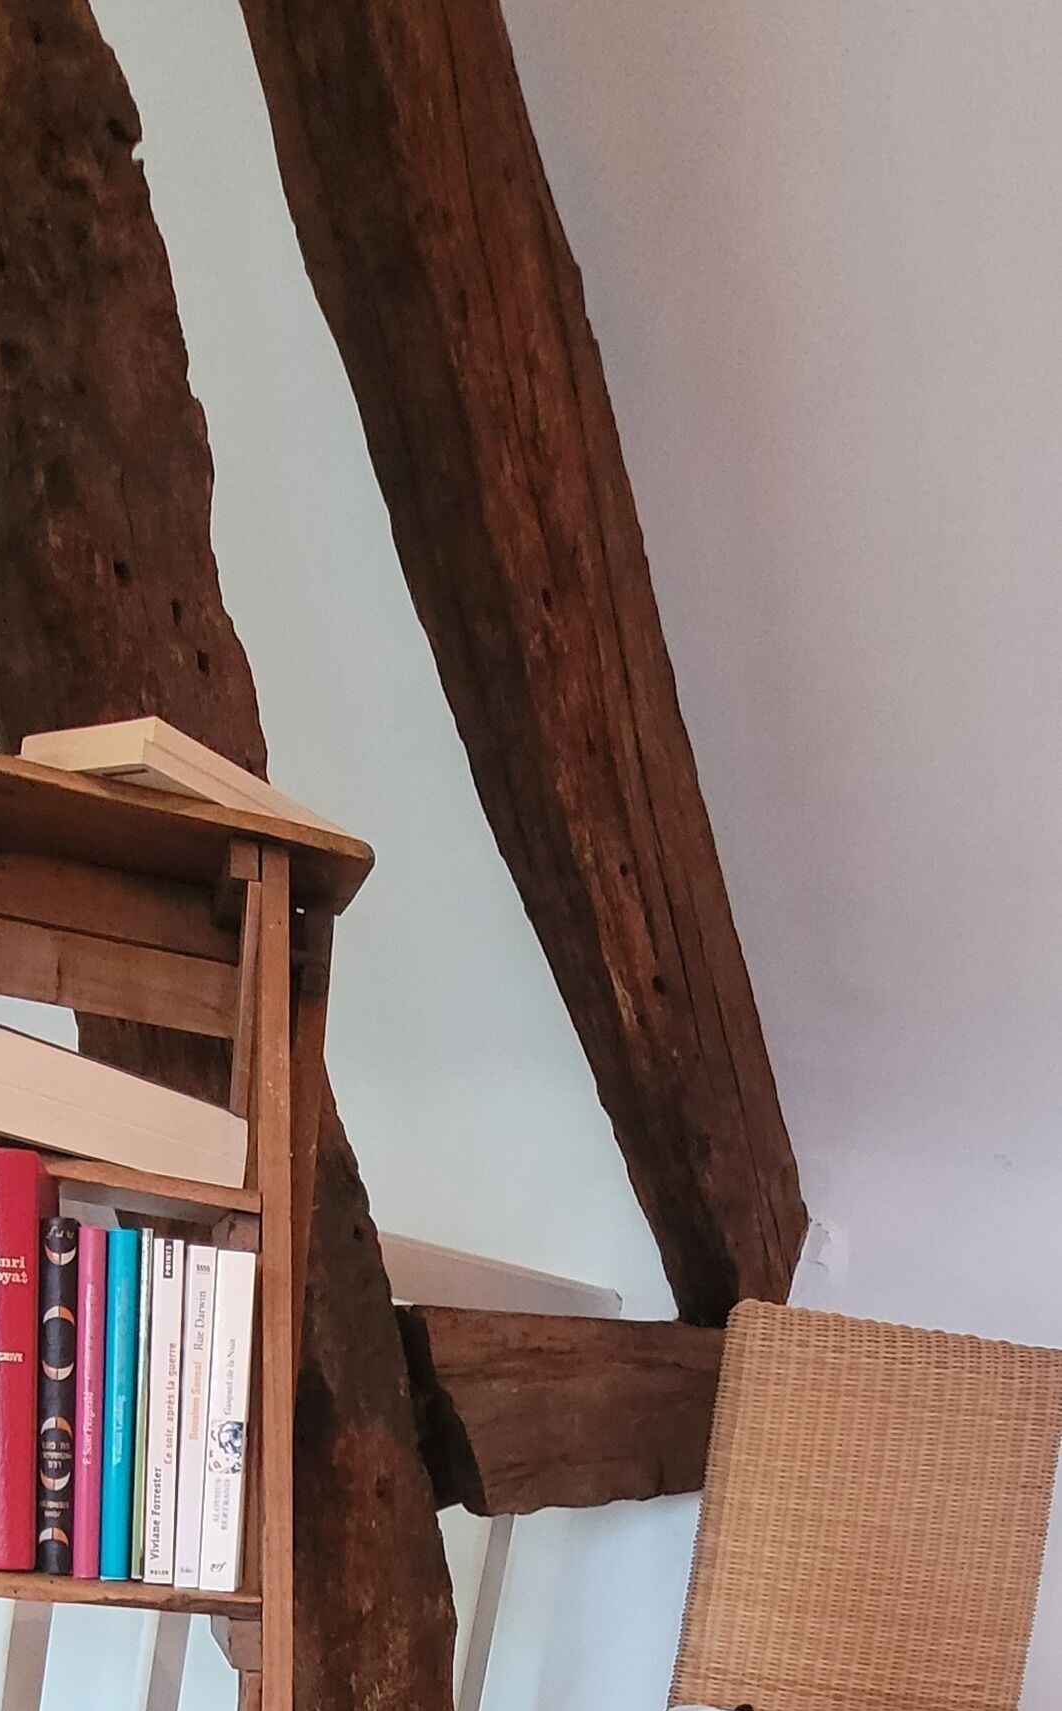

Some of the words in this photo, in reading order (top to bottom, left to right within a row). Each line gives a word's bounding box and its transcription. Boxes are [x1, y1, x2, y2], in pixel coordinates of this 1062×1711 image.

[164, 1244, 173, 1277] POINTS
[194, 1291, 207, 1329] Darwin
[193, 1331, 204, 1351] Rue
[168, 1343, 178, 1377] guerre
[166, 1380, 175, 1391] la
[165, 1395, 176, 1423] après
[164, 1450, 173, 1465] Ce
[151, 1466, 162, 1516] Forrester
[150, 1520, 161, 1561] Viviane
